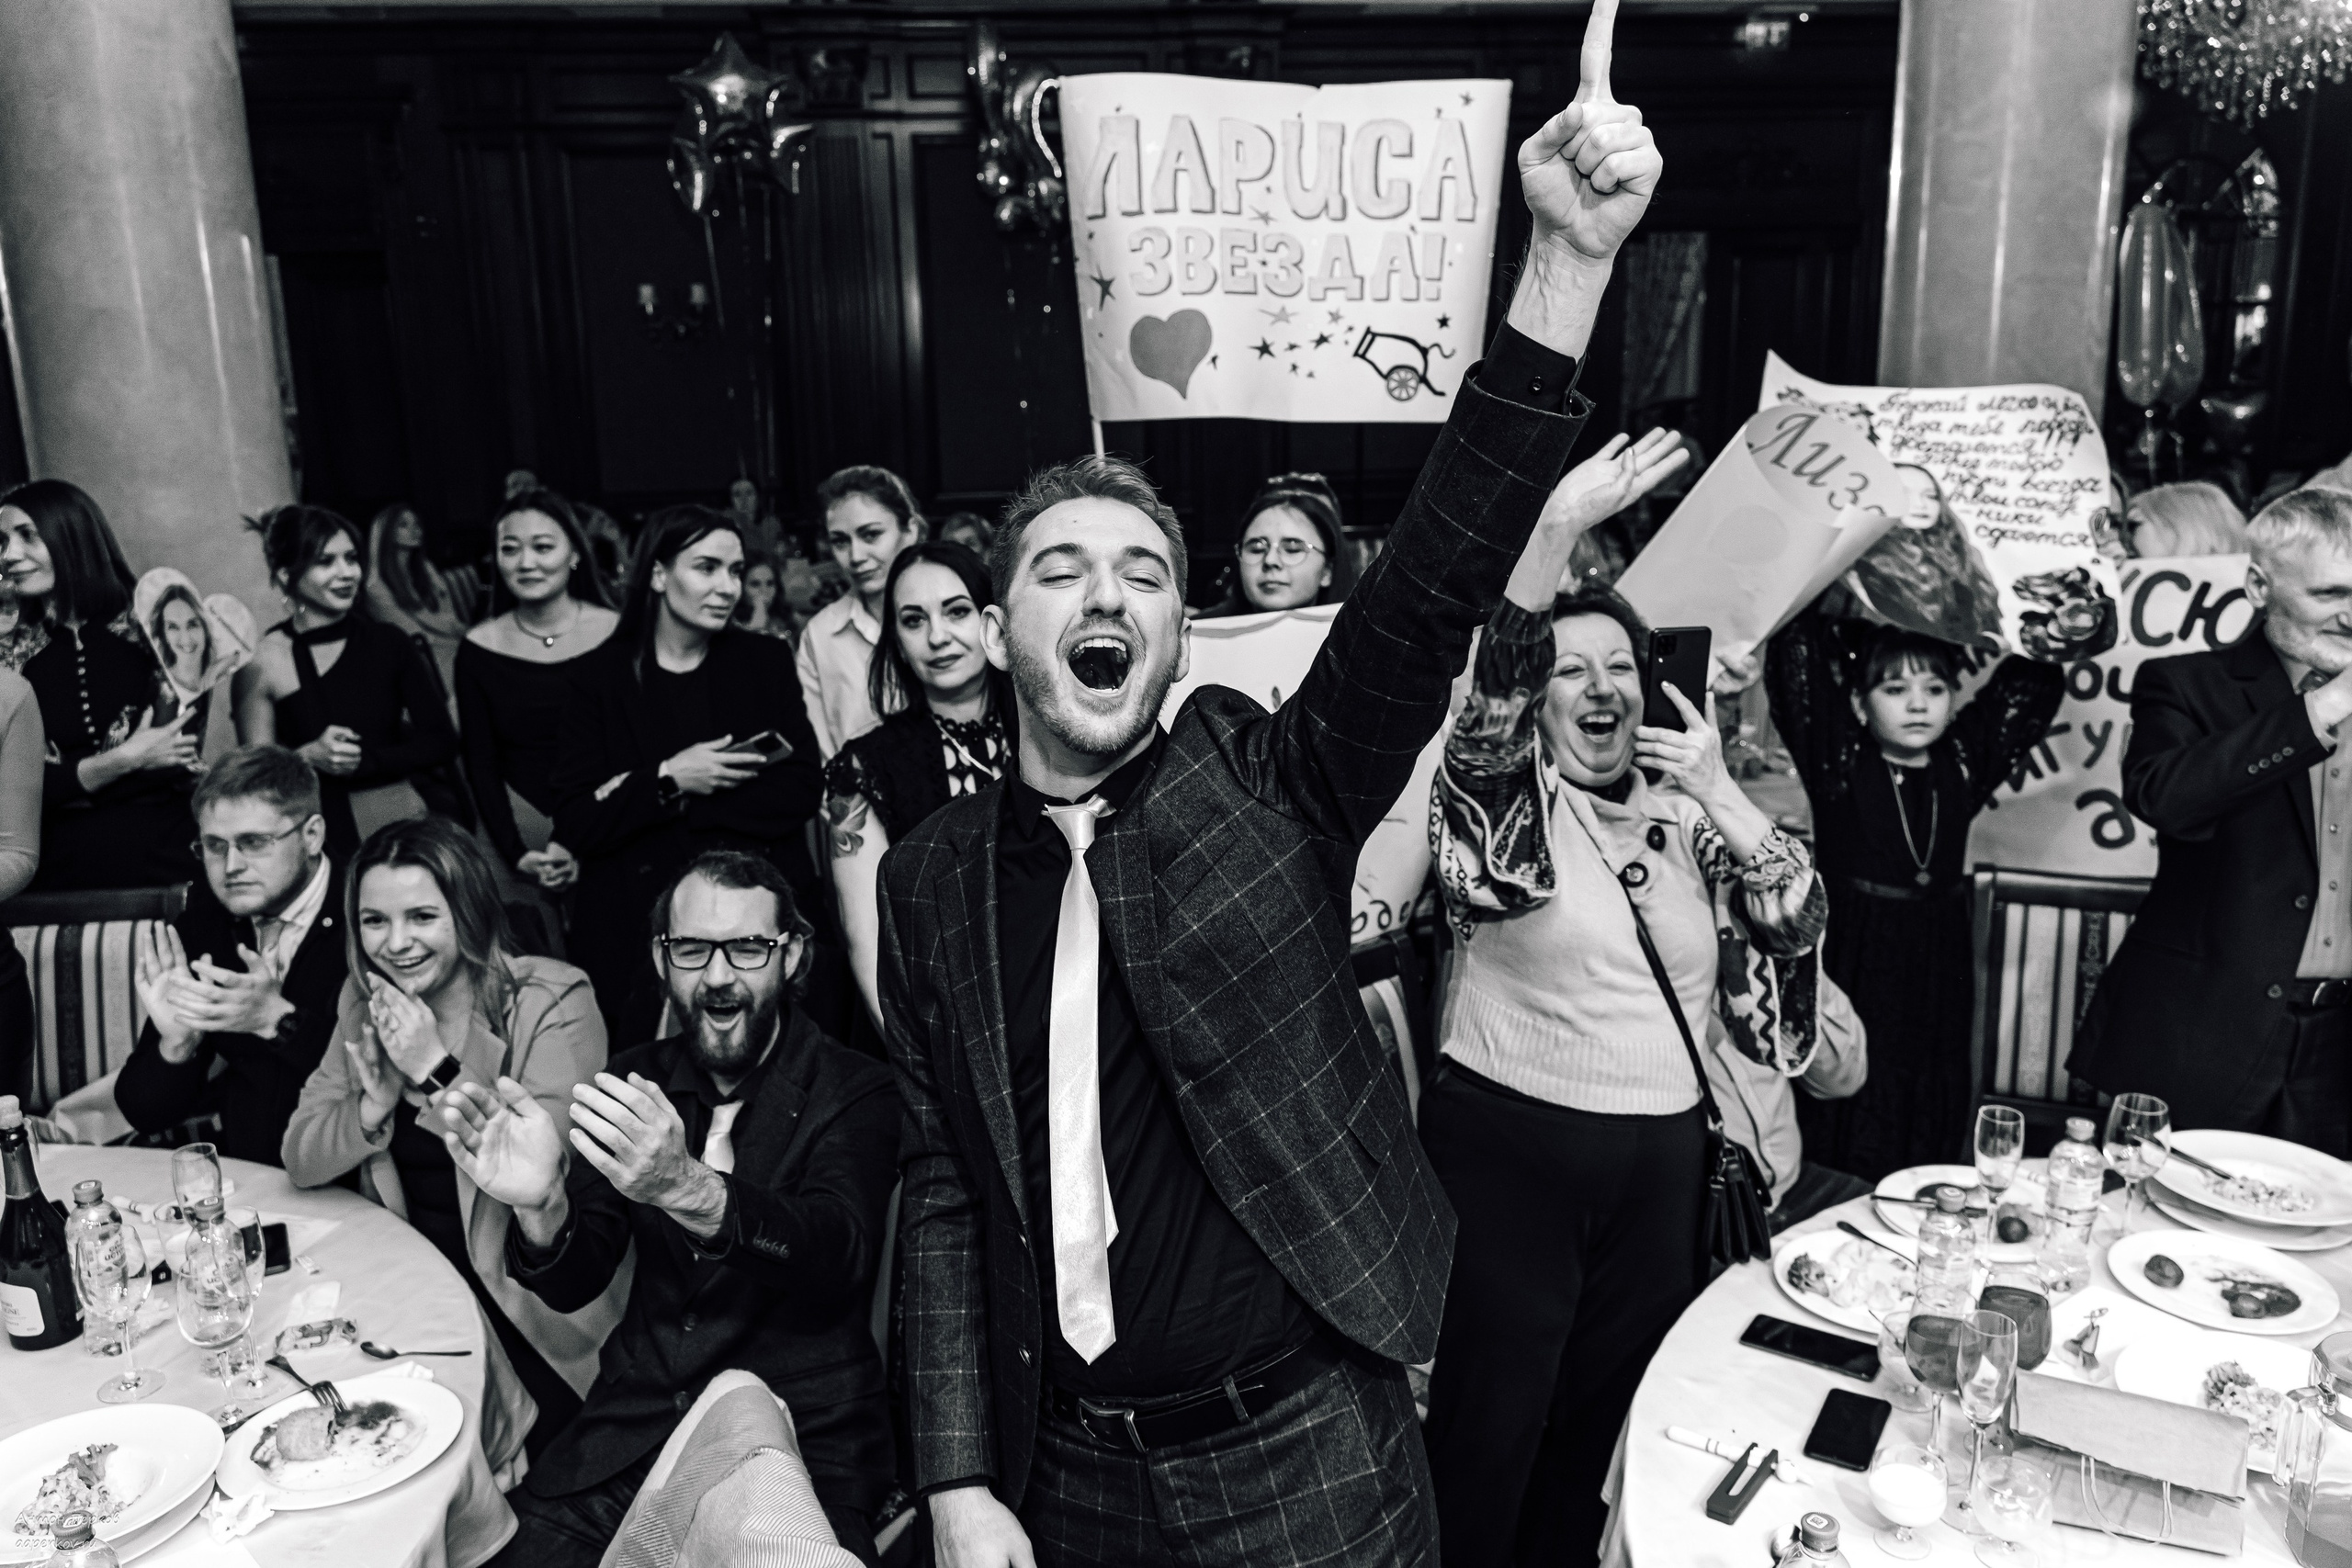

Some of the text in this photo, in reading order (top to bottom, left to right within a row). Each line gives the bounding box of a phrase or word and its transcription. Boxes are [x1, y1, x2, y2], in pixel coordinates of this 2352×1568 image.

[1086, 115, 1478, 222] ЛАРИСА
[1128, 227, 1448, 301] ЗВЕЗДА!
[1751, 412, 1887, 518] Лиз
